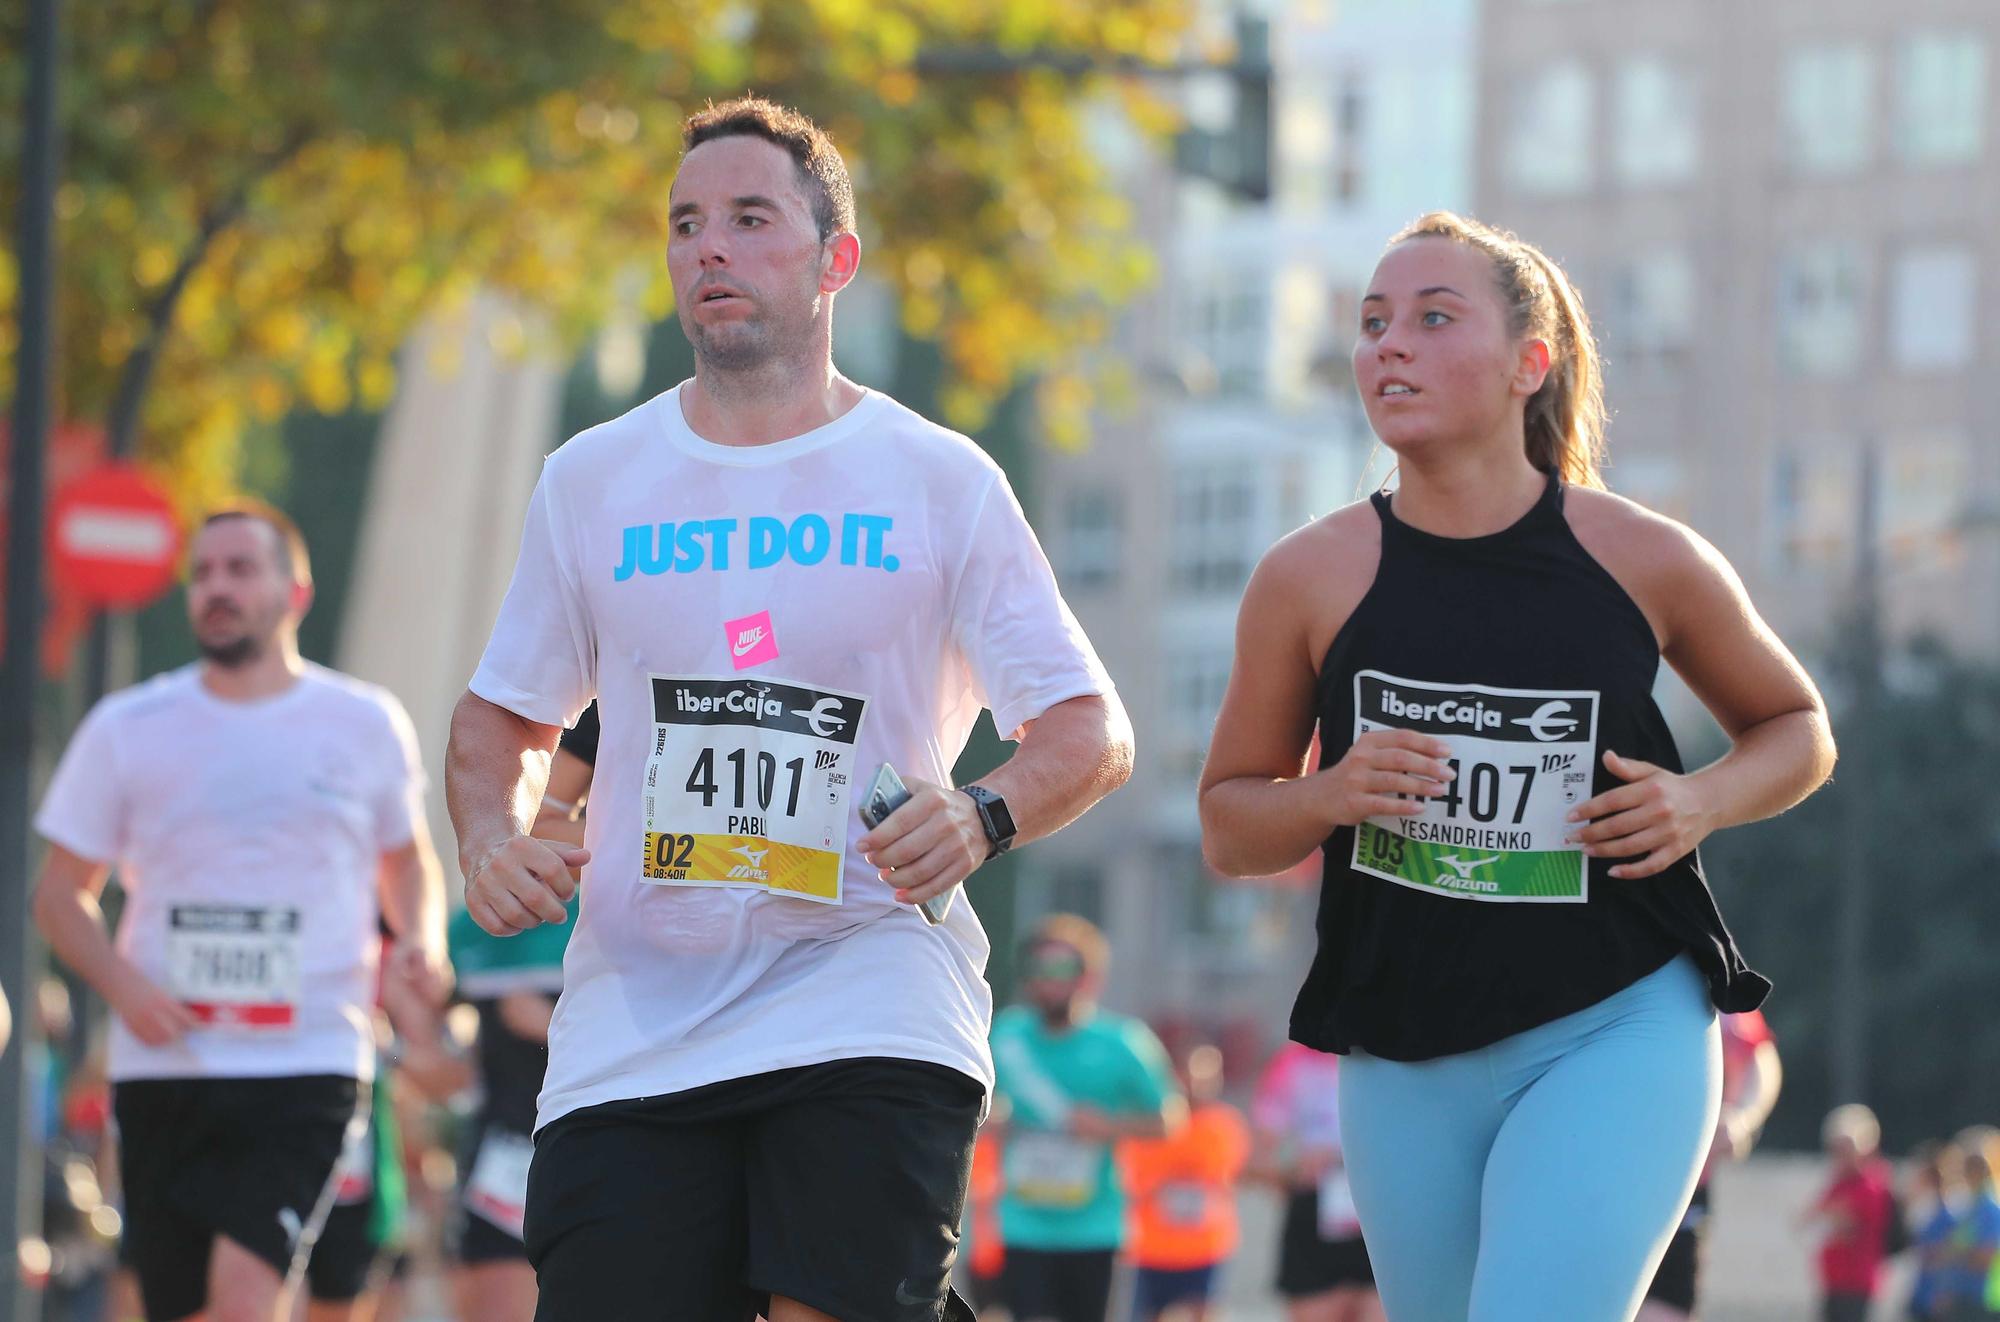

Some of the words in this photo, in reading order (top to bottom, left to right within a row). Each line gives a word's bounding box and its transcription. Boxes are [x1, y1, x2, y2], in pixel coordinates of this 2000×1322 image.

[614, 518, 737, 582] JUST
[748, 513, 831, 570] DO
[841, 513, 900, 573] IT.
[738, 625, 763, 645] NIKE
[675, 689, 783, 721] iberCaja
[1380, 689, 1503, 732] iberCaja
[655, 728, 667, 757] 226ERS
[685, 747, 804, 818] 4101
[1398, 758, 1536, 825] 407
[728, 815, 768, 837] PABL
[1398, 817, 1532, 851] YESANDRIENKO
[643, 832, 652, 878] SALIDA
[656, 833, 695, 868] 02
[1373, 828, 1405, 865] 03
[653, 867, 687, 880] 08:40H
